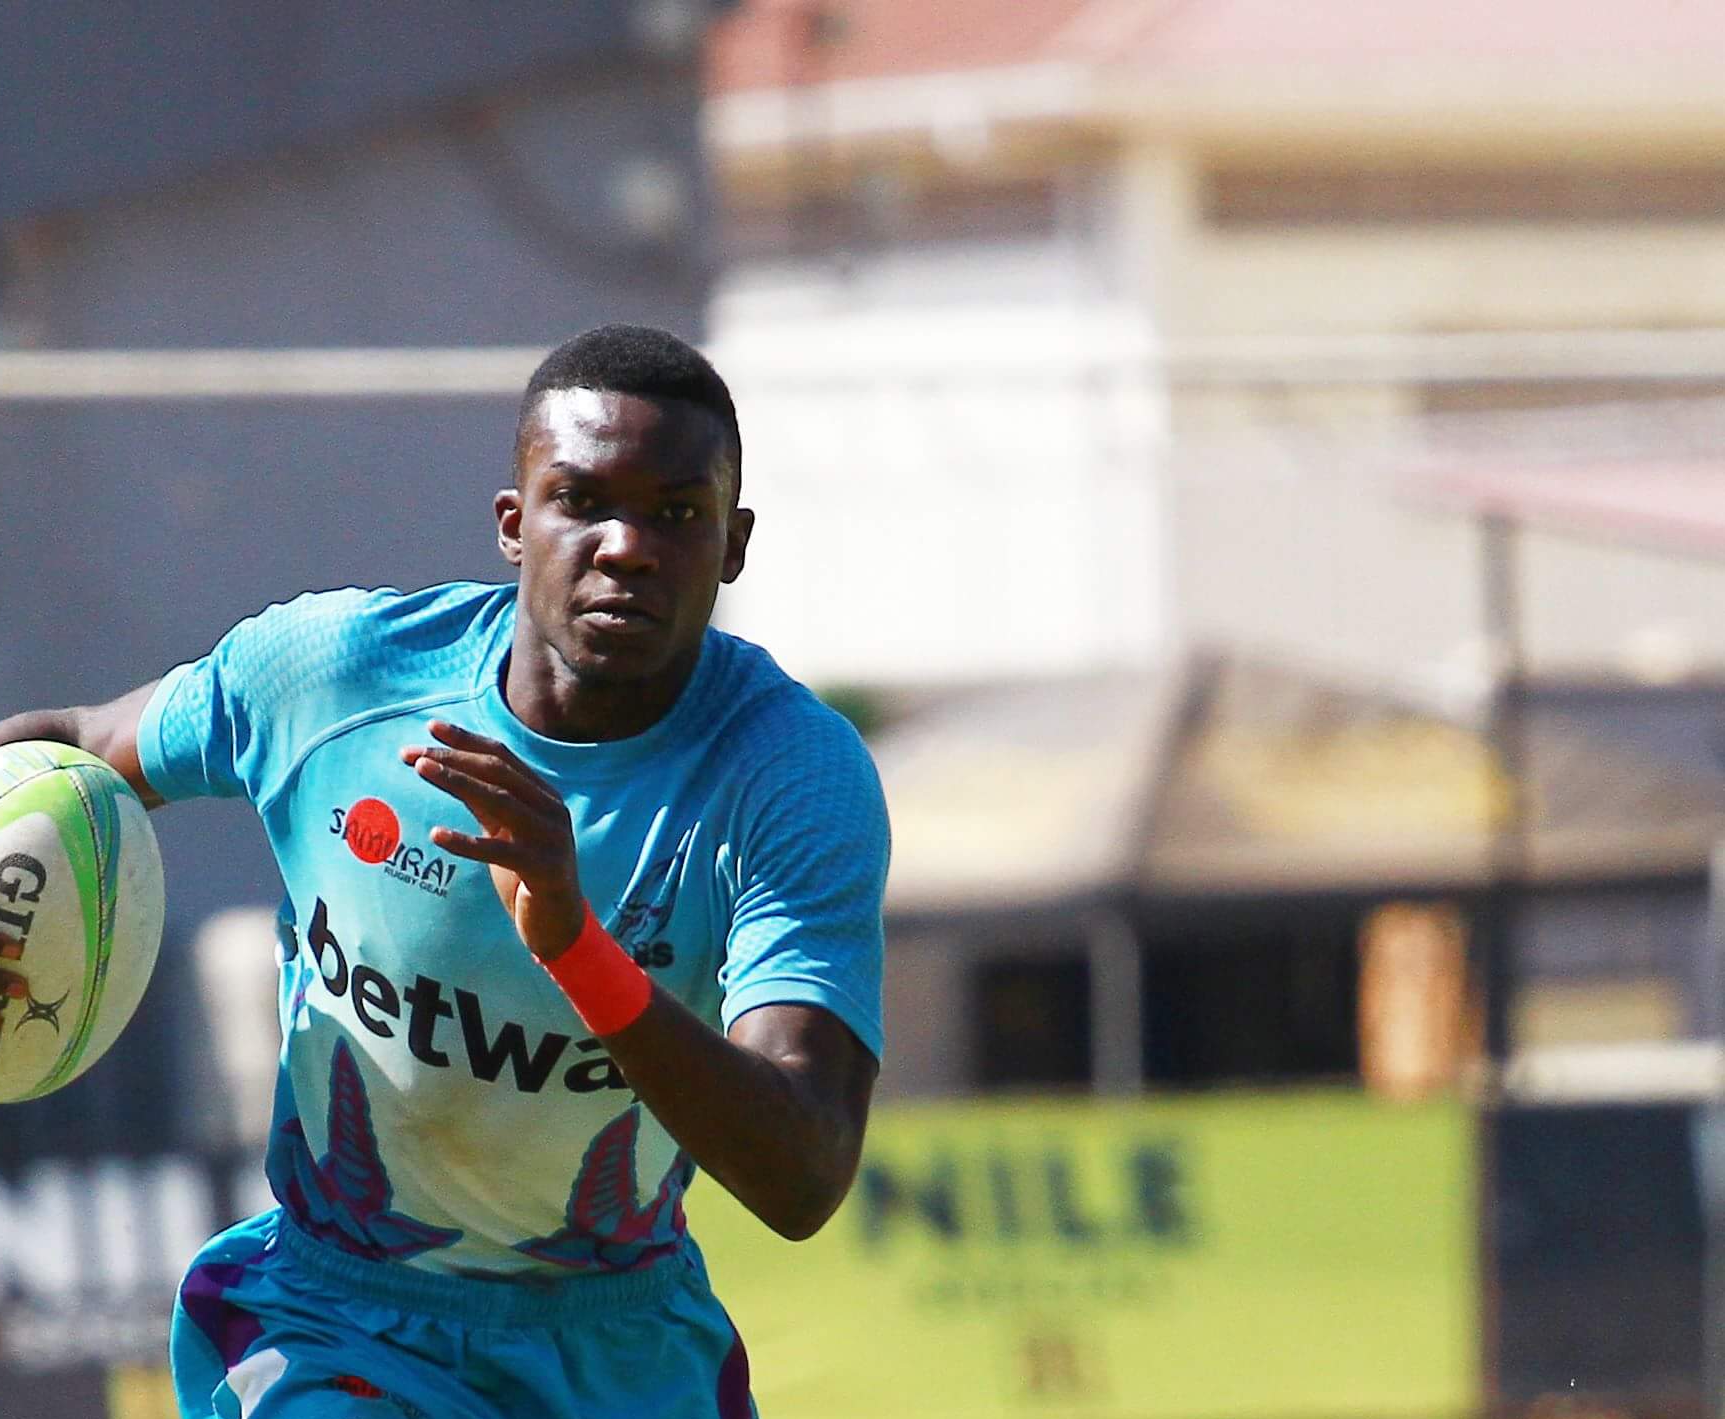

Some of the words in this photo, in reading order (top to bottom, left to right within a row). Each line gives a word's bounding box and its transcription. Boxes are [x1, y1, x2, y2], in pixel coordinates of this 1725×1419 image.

[383, 865, 420, 885] RUGBY
[419, 880, 448, 898] GEAR
[308, 896, 632, 1093] betwa
[855, 1138, 1201, 1257] NILE
